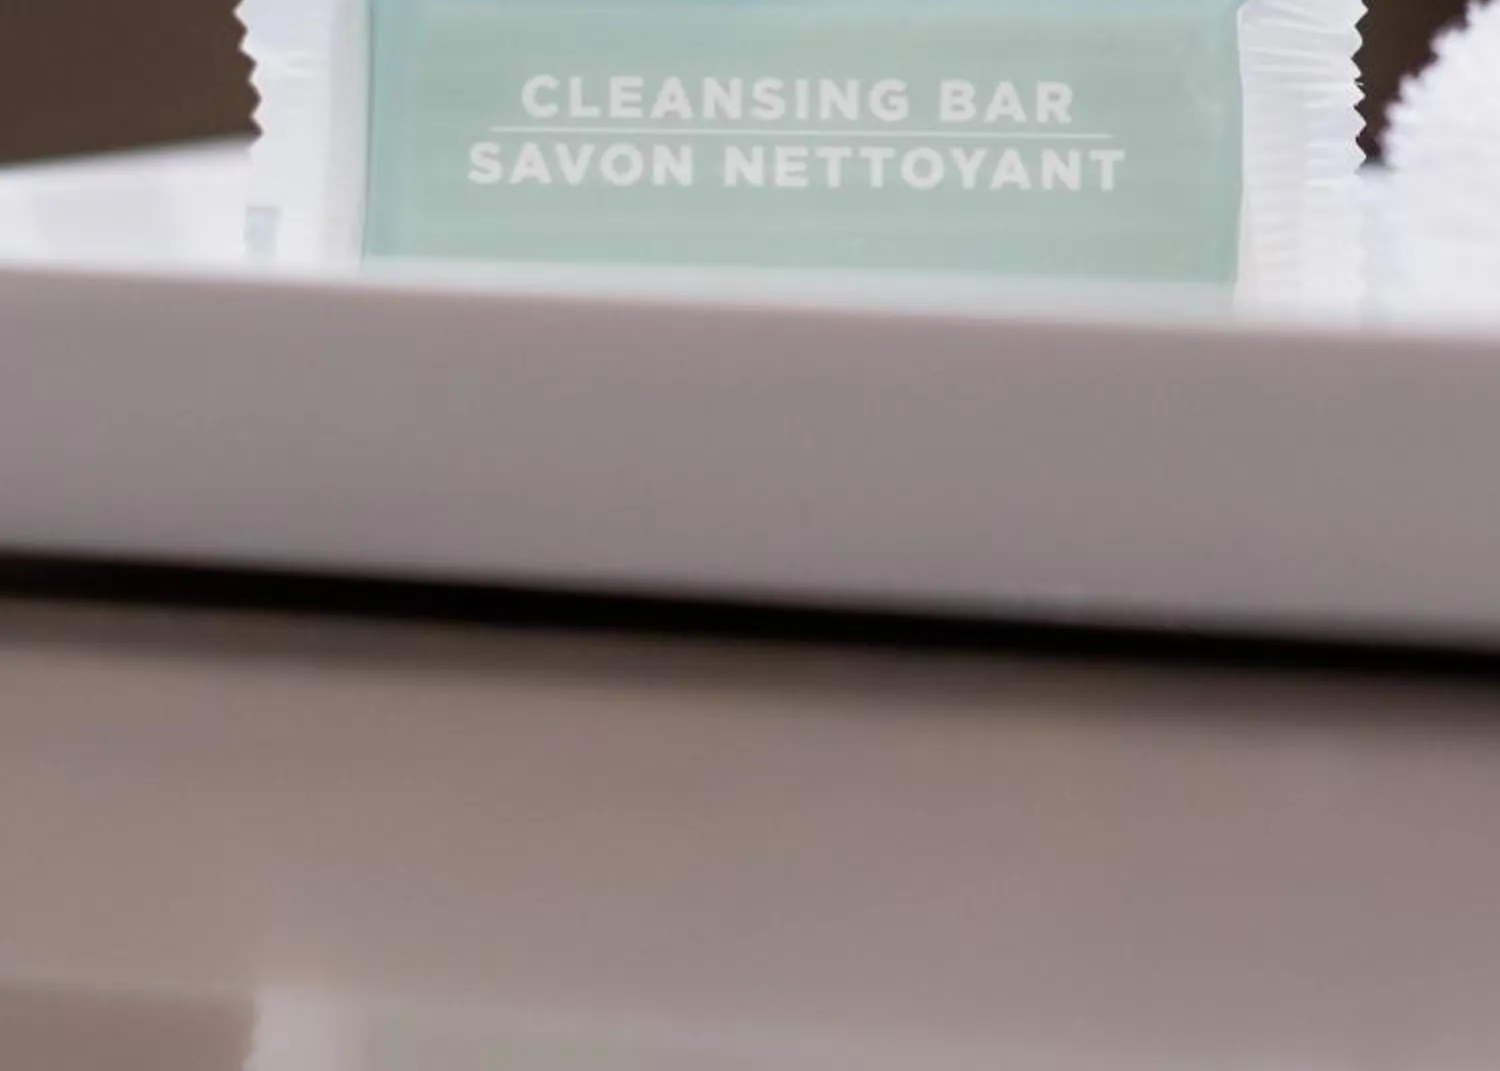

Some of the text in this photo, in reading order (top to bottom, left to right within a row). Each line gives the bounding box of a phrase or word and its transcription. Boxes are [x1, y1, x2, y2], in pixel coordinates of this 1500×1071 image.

[519, 73, 1075, 124] CLEANSING BAR
[466, 140, 1126, 193] SAVON NETTOYANT
